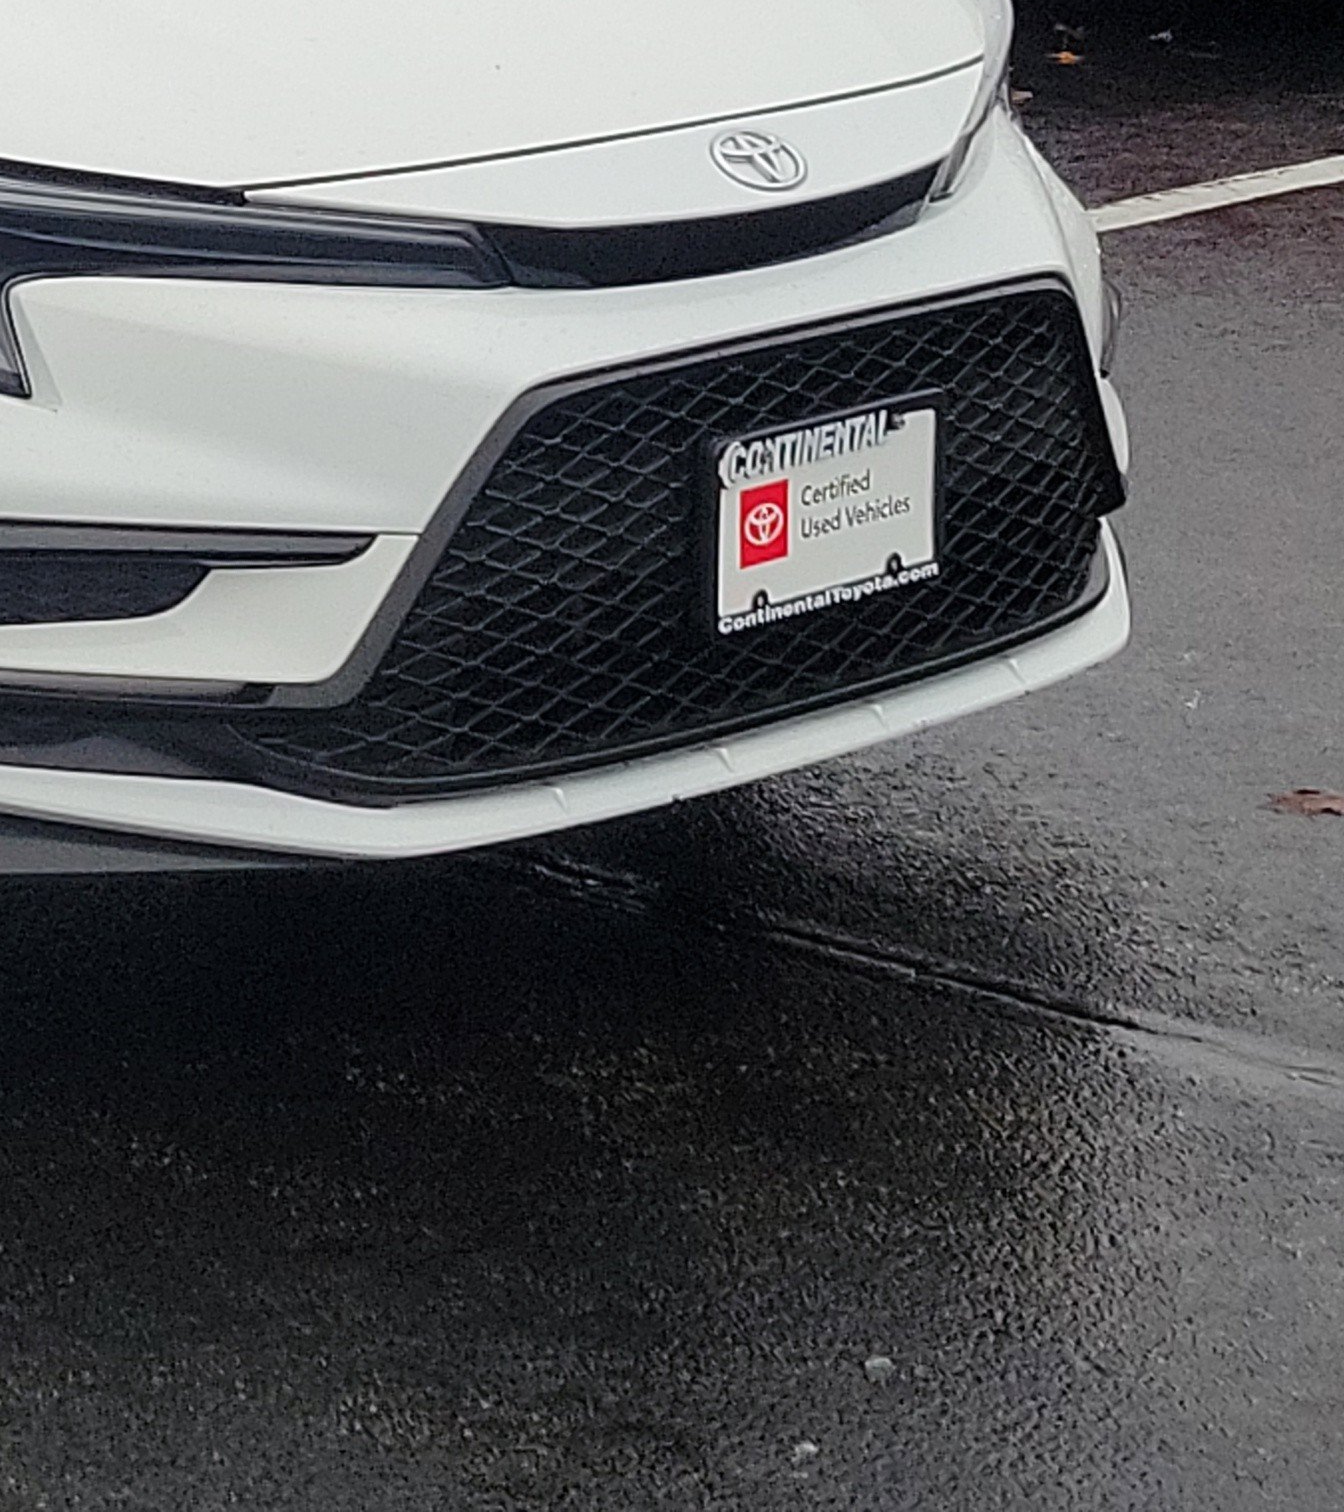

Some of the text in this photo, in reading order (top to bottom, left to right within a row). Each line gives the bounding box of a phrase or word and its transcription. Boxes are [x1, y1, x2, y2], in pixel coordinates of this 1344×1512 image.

[729, 410, 888, 480] CONTINENTAL
[801, 468, 870, 506] Certified
[801, 494, 910, 538] Used Vehicles
[717, 562, 940, 635] ContinentalToyota.com
